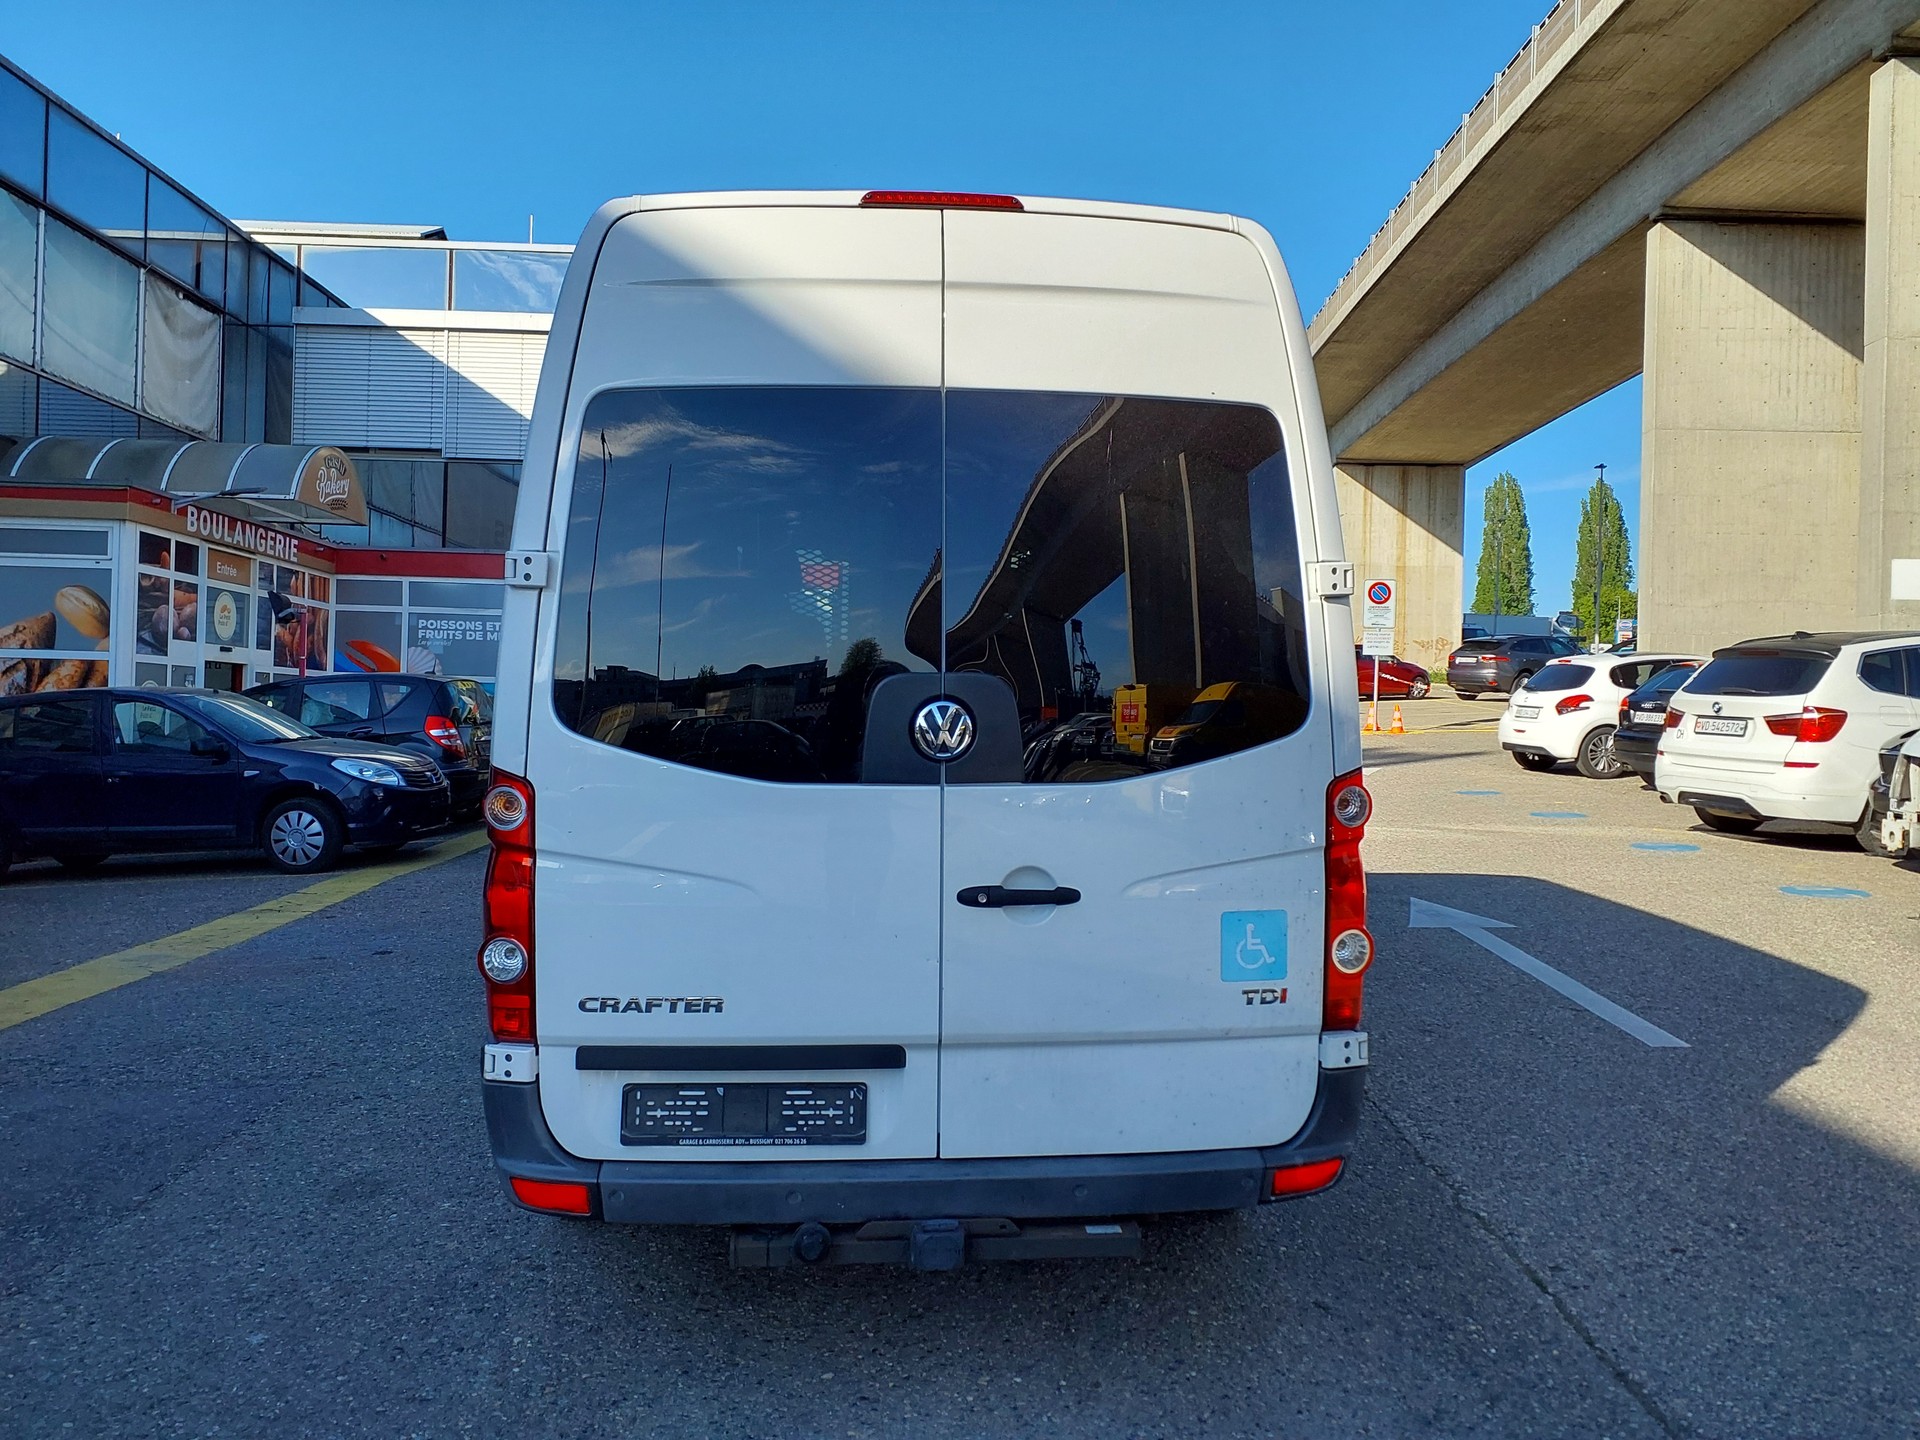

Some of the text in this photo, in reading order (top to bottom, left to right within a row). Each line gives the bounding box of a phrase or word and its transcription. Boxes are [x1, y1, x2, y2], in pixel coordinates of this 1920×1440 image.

[316, 466, 350, 503] Bakery
[187, 505, 299, 562] BOULANGERIE
[216, 562, 237, 577] Entrée
[418, 619, 501, 631] POISSONS ET
[418, 629, 462, 640] FRUITS
[466, 631, 483, 641] DE
[1711, 722, 1740, 733] 542572
[1242, 988, 1288, 1005] TDI
[578, 997, 724, 1014] CRAFTER
